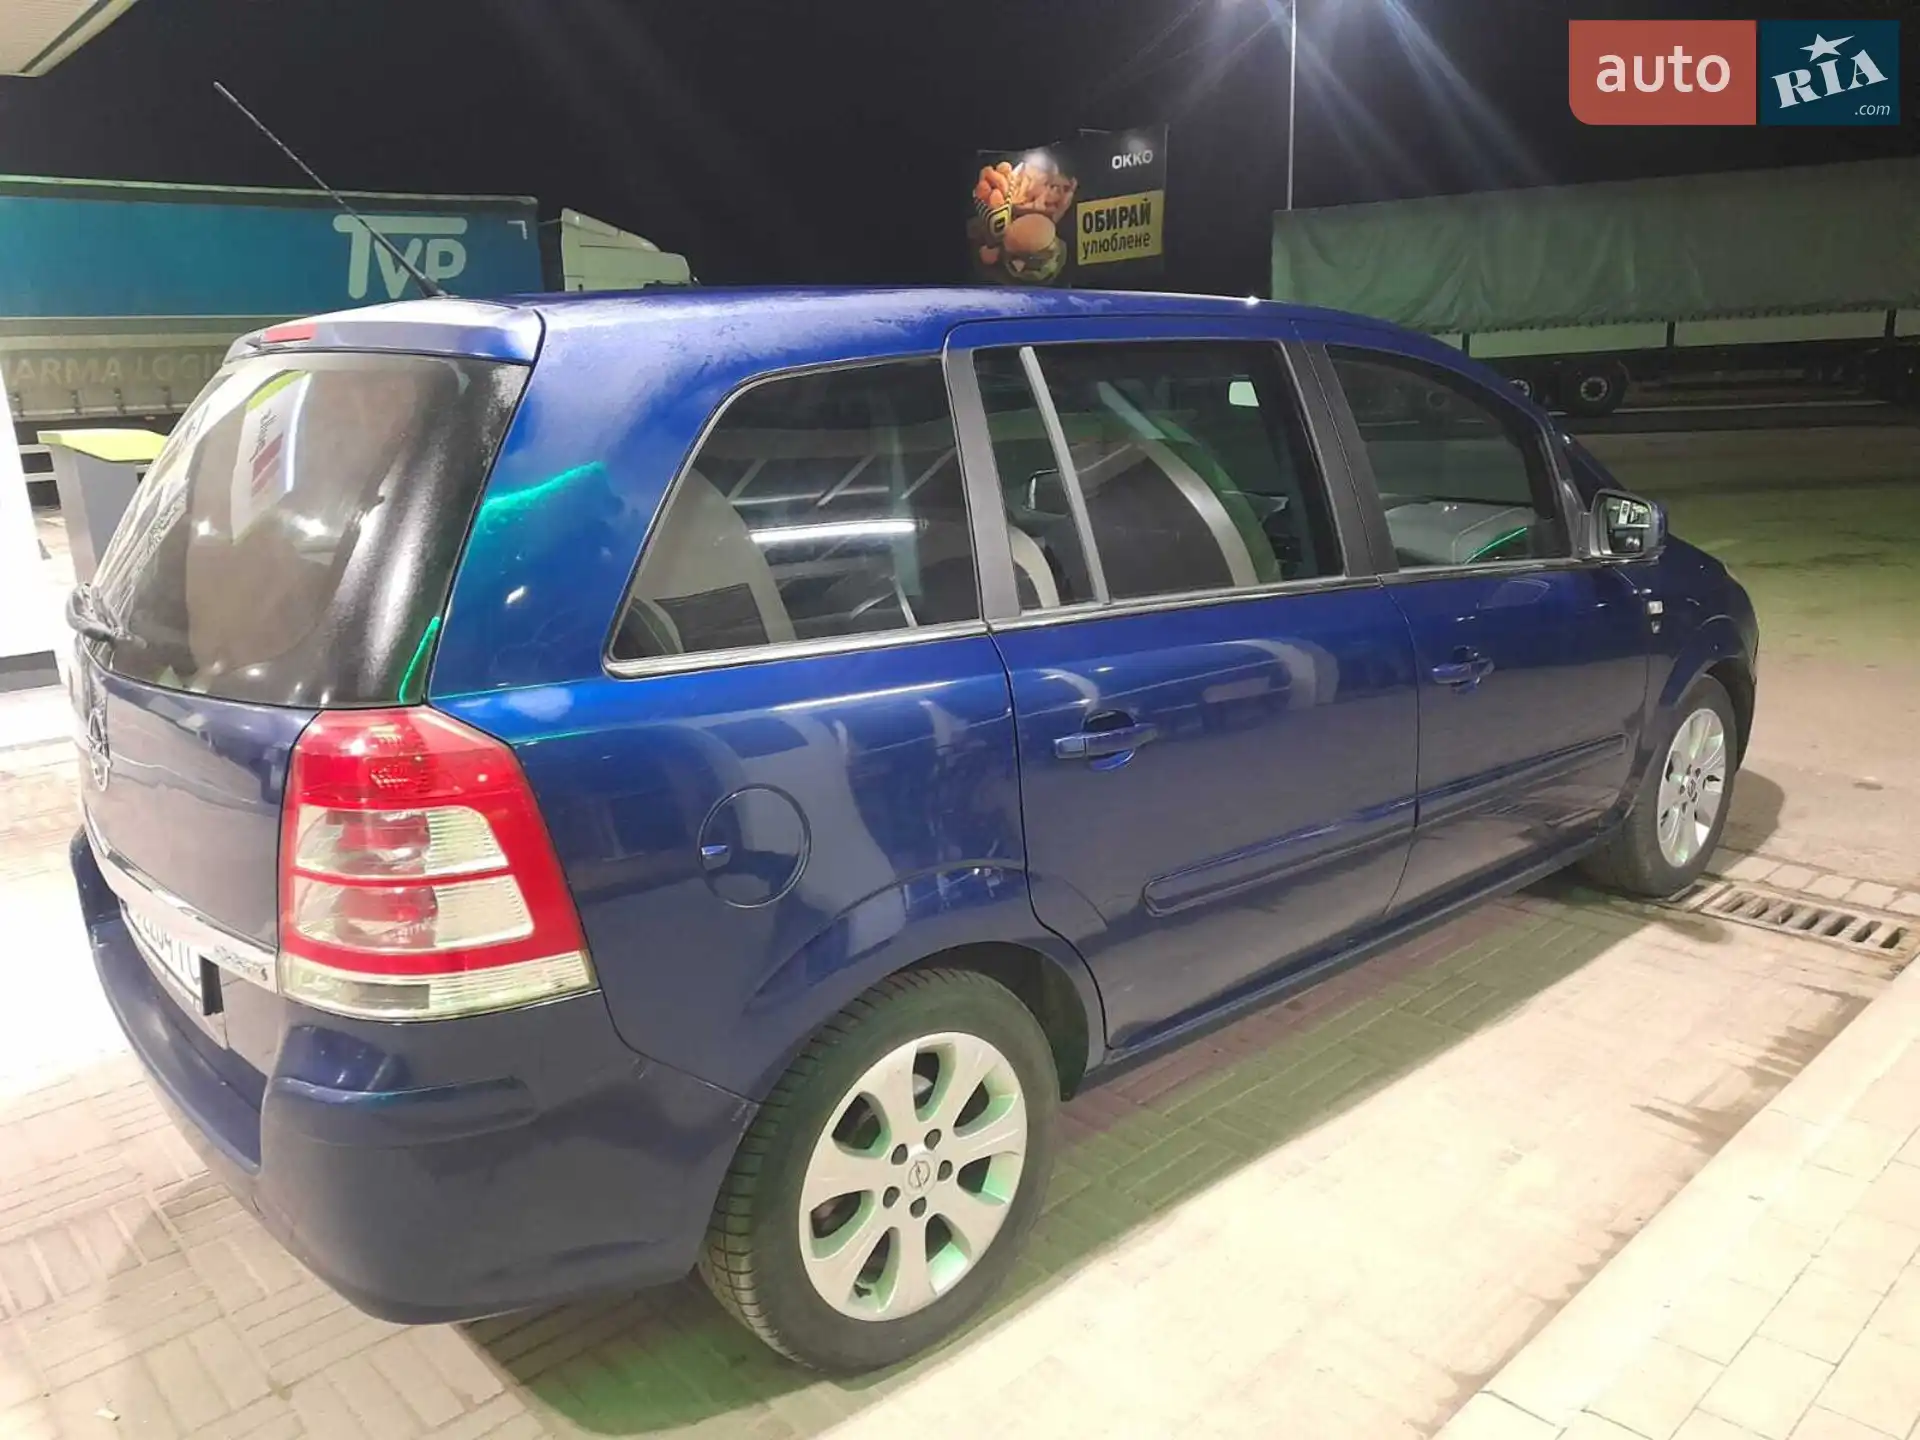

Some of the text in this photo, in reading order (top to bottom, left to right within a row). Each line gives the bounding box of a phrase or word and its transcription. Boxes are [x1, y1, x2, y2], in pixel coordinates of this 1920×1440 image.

[1111, 150, 1153, 169] OKKO
[1082, 198, 1152, 234] ОБИРАЙ
[332, 214, 468, 299] TVP
[1082, 232, 1151, 260] улюблене
